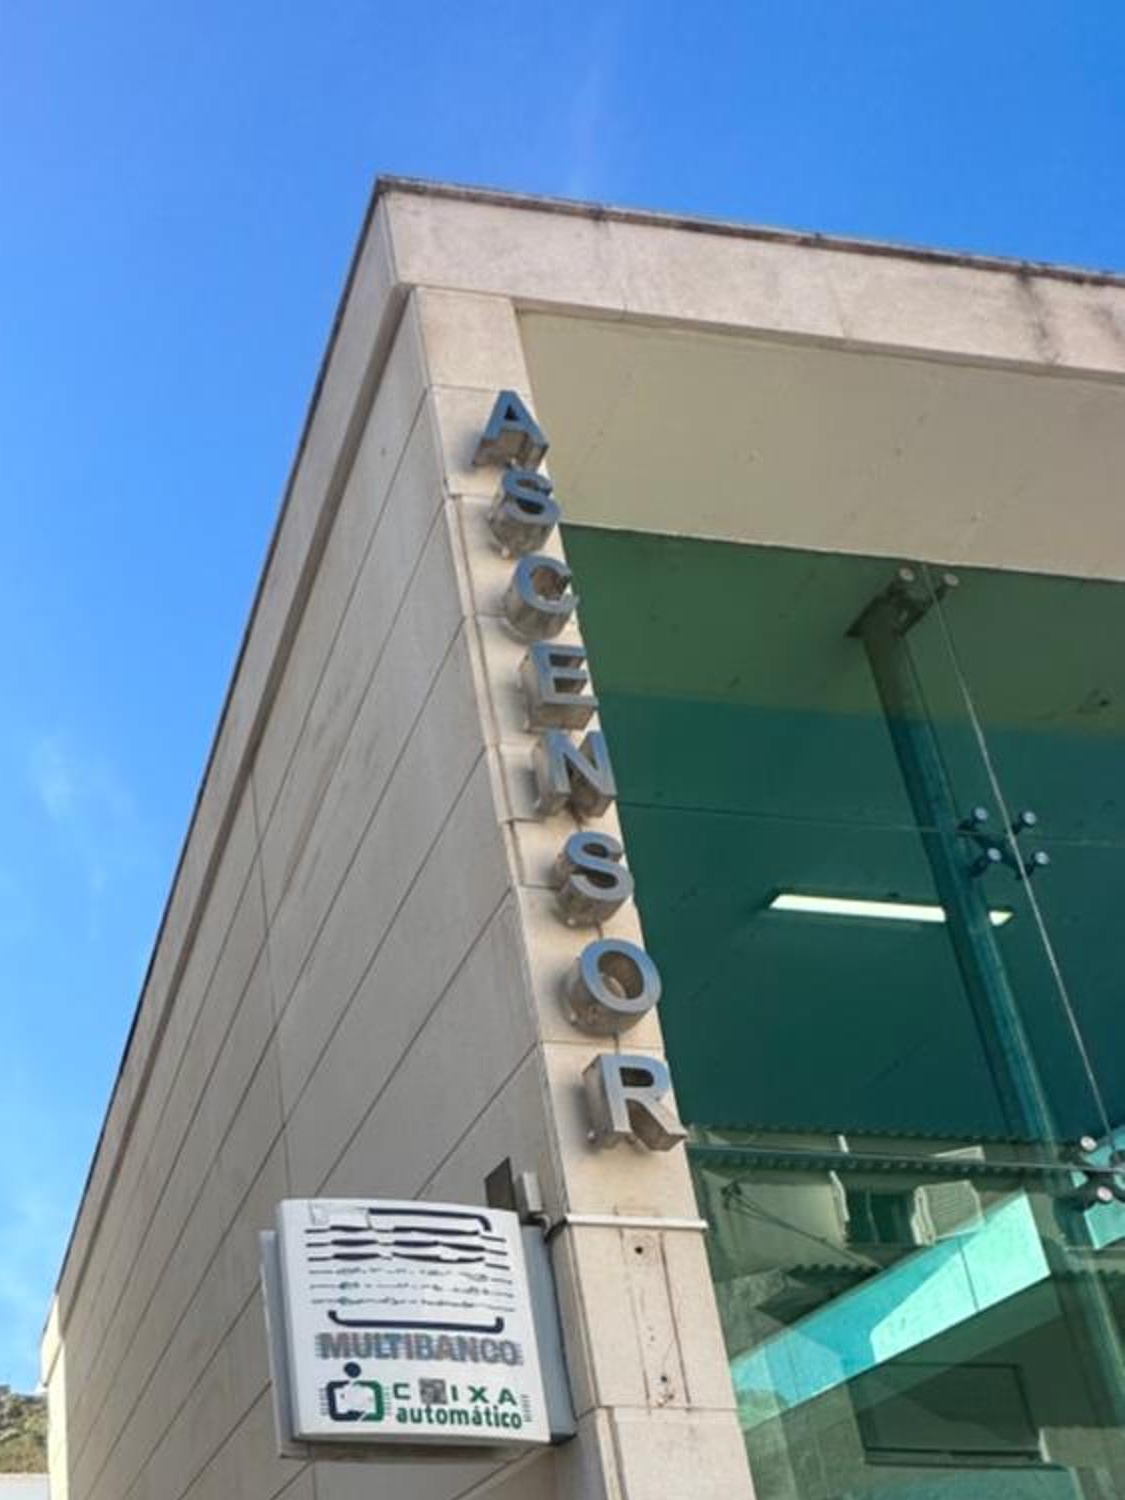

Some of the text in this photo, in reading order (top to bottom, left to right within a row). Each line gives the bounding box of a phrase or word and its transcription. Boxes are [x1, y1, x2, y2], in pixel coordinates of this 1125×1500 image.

[475, 389, 687, 1152] ASCENSOR
[315, 1332, 523, 1366] MULTIBANCO
[396, 1404, 523, 1430] automático
